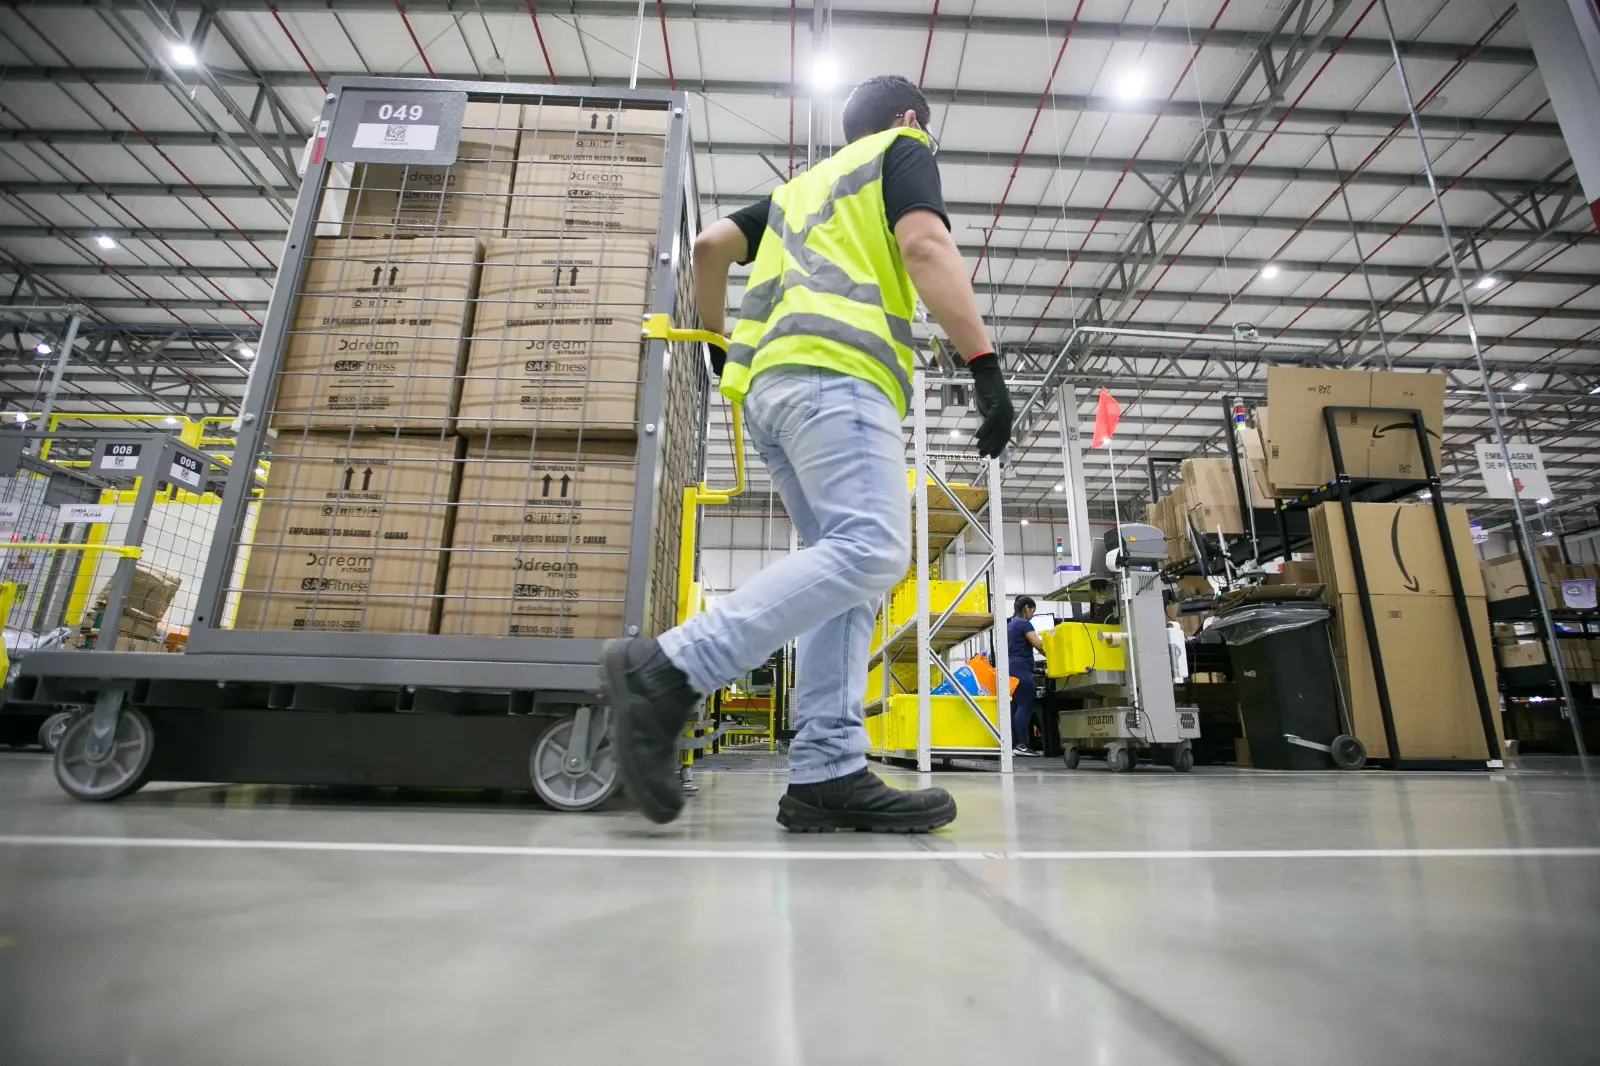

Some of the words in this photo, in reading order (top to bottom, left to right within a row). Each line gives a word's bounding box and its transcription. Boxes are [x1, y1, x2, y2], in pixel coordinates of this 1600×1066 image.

[378, 104, 423, 121] 049
[409, 318, 432, 326] CAXAS
[334, 360, 396, 371] SACFtness
[112, 445, 133, 454] 008
[1484, 452, 1534, 460] EMBAGEM
[179, 456, 197, 470] 008
[1497, 462, 1538, 470] PESENTE
[545, 533, 572, 543] MÁXIM
[583, 536, 606, 544] CAIXAS
[305, 619, 362, 628] 000-101-2555
[1087, 714, 1114, 726] amazon
